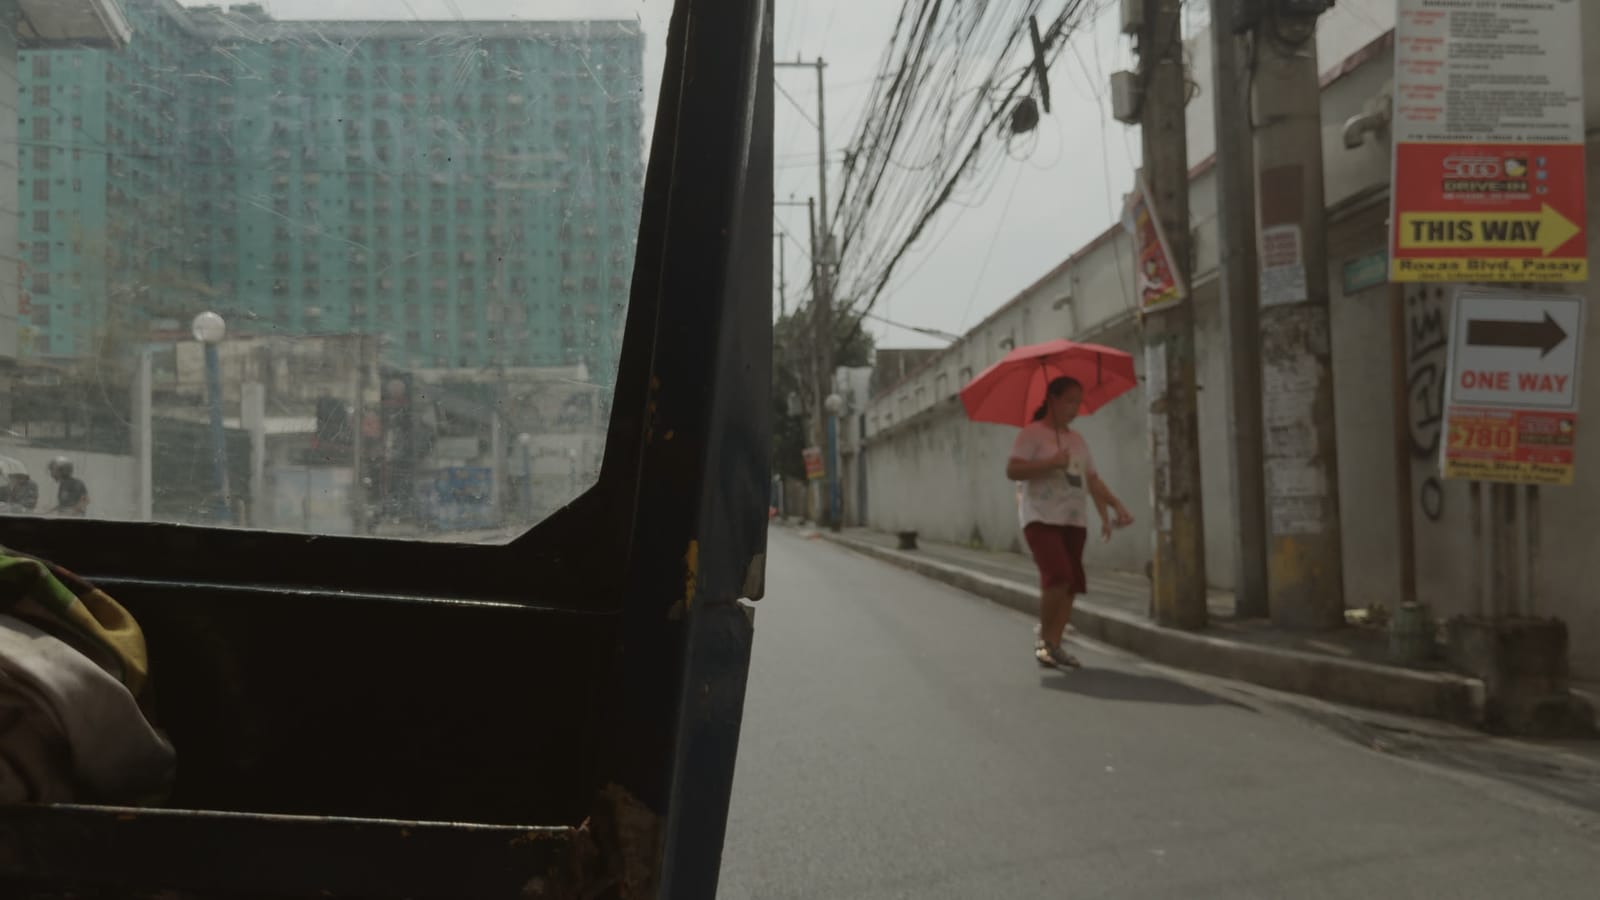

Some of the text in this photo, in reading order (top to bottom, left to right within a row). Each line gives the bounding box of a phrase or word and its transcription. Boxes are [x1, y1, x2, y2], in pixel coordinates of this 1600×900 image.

[1410, 220, 1541, 241] THIS WAY
[1400, 259, 1459, 270] Roxas
[1522, 259, 1582, 272] Pasay
[1460, 370, 1569, 393] ONE WAY
